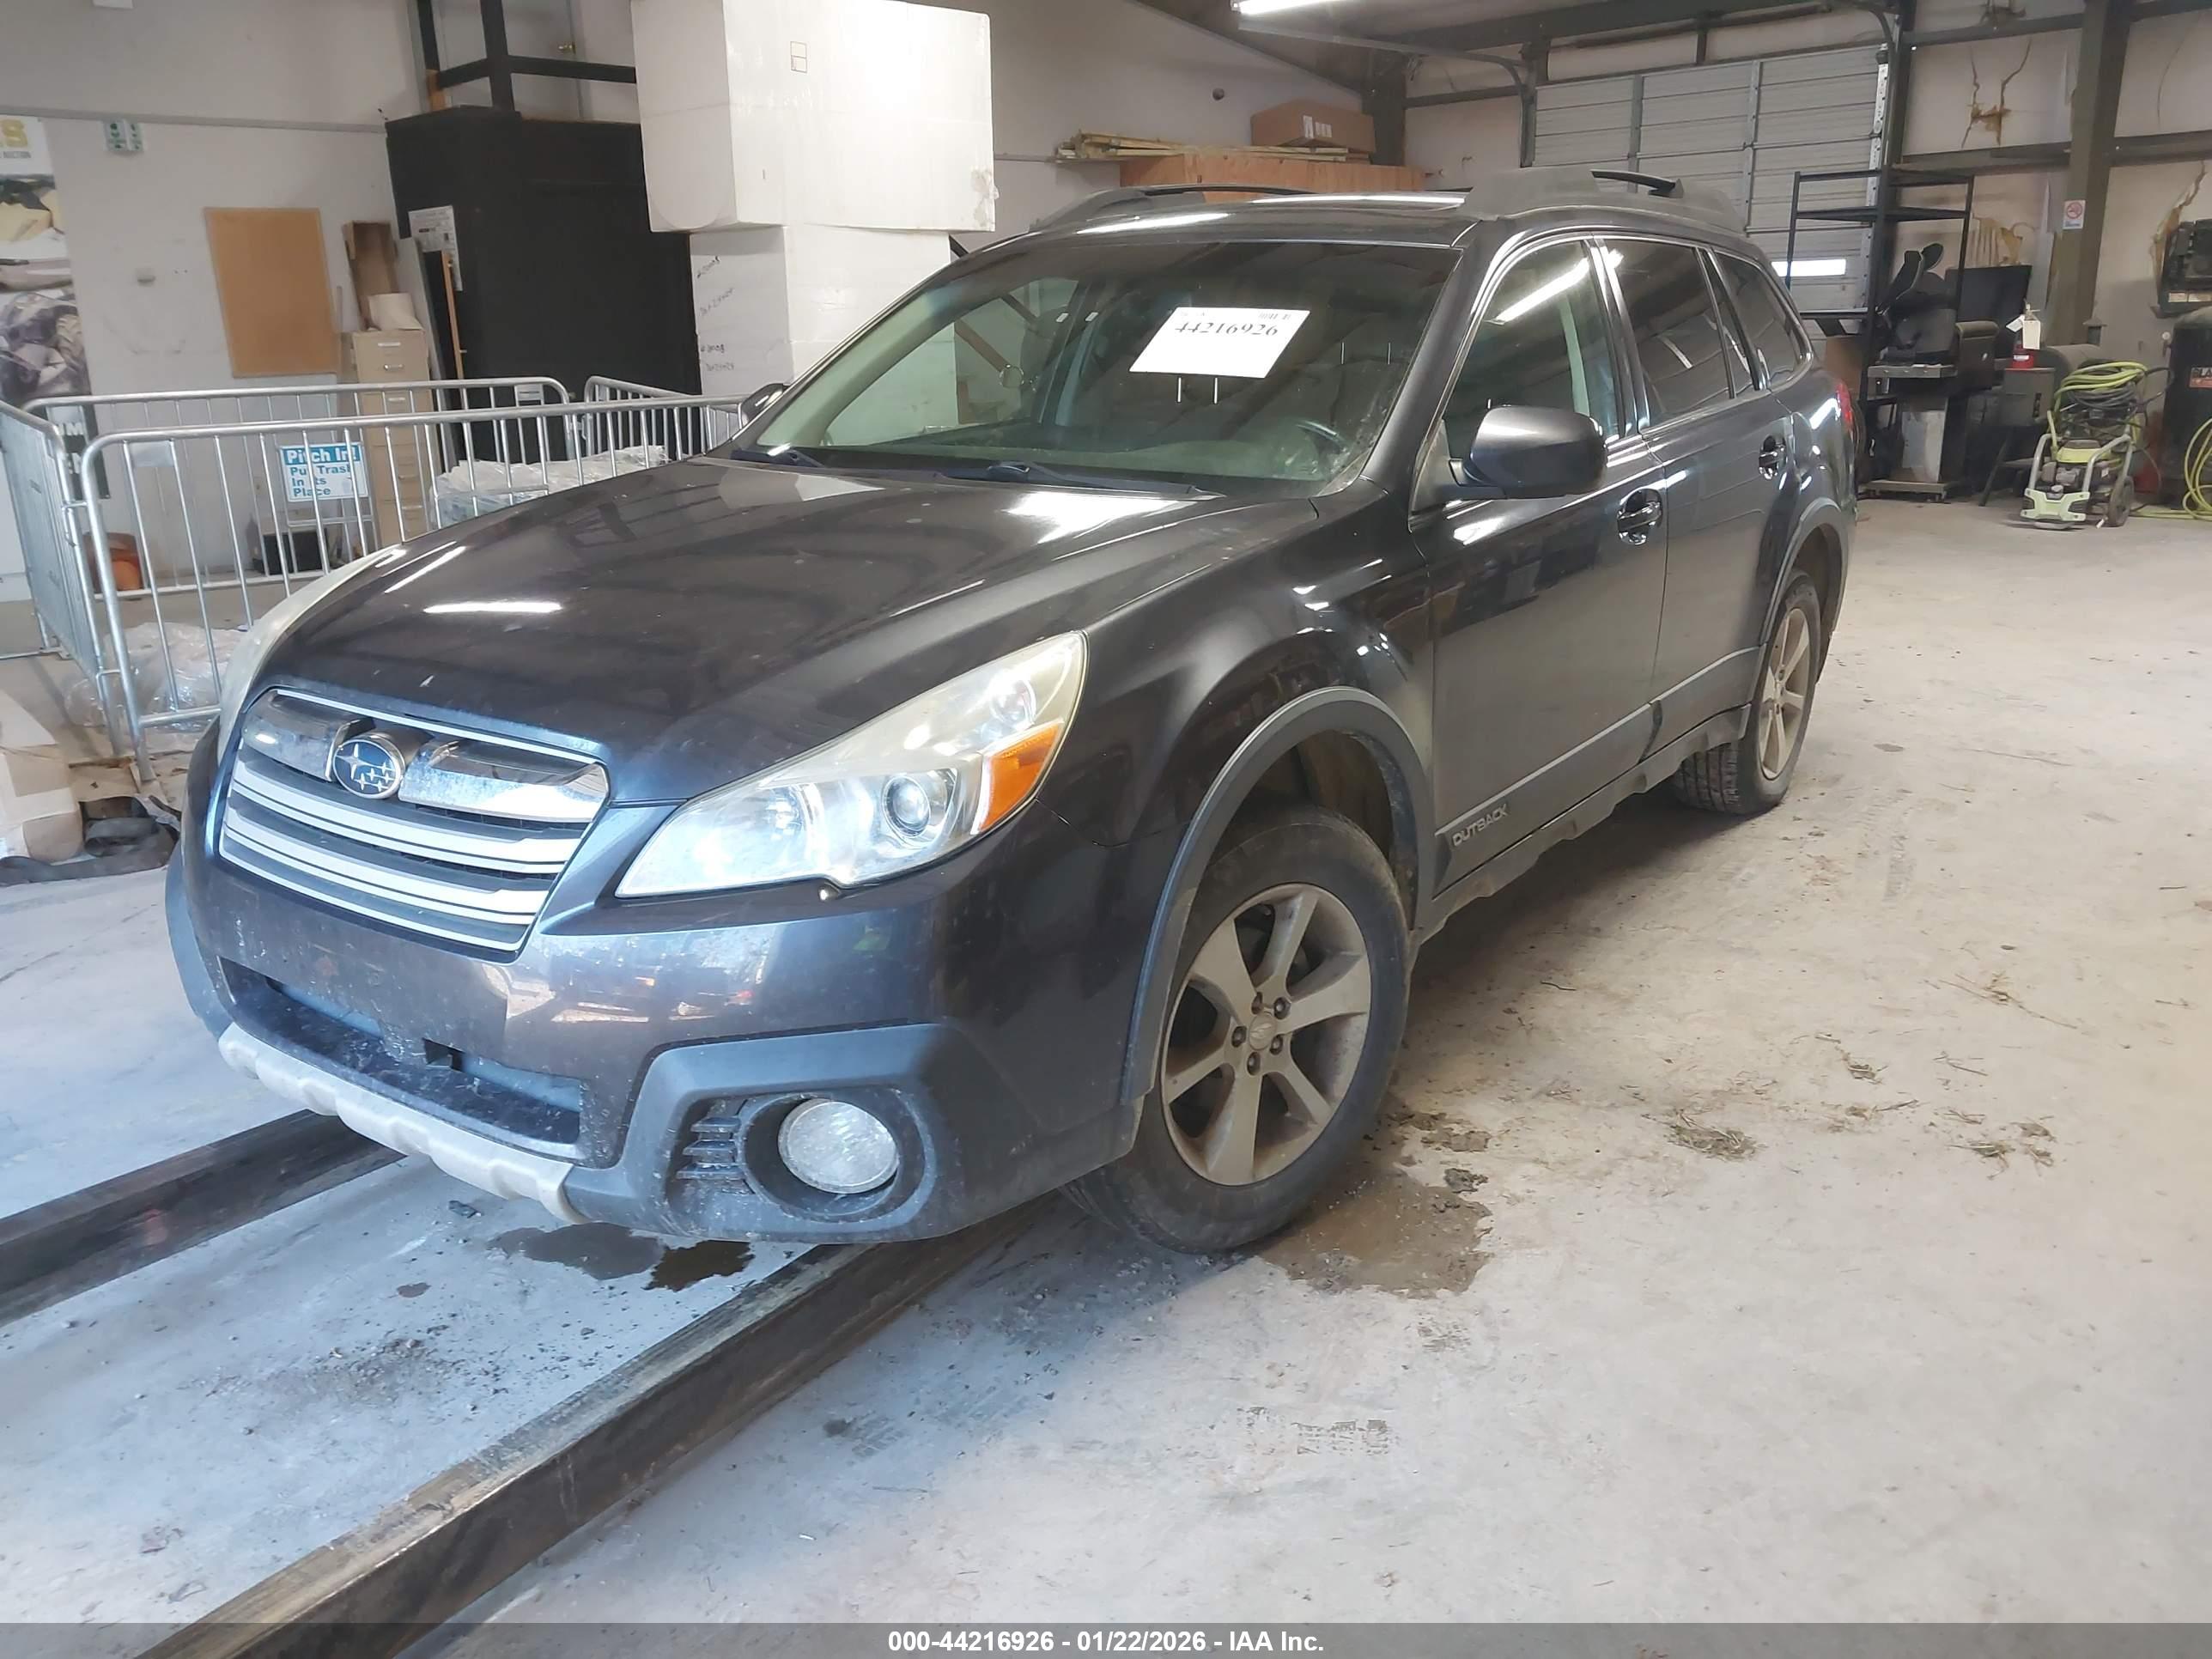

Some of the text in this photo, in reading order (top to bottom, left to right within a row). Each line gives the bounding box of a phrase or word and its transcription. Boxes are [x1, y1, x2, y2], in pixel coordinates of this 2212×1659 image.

[0, 118, 28, 148] S
[1175, 322, 1279, 336] 44216926
[286, 447, 331, 464] Pich
[290, 466, 310, 476] Pu
[292, 477, 305, 487] In
[1452, 803, 1508, 846] OUTBACK
